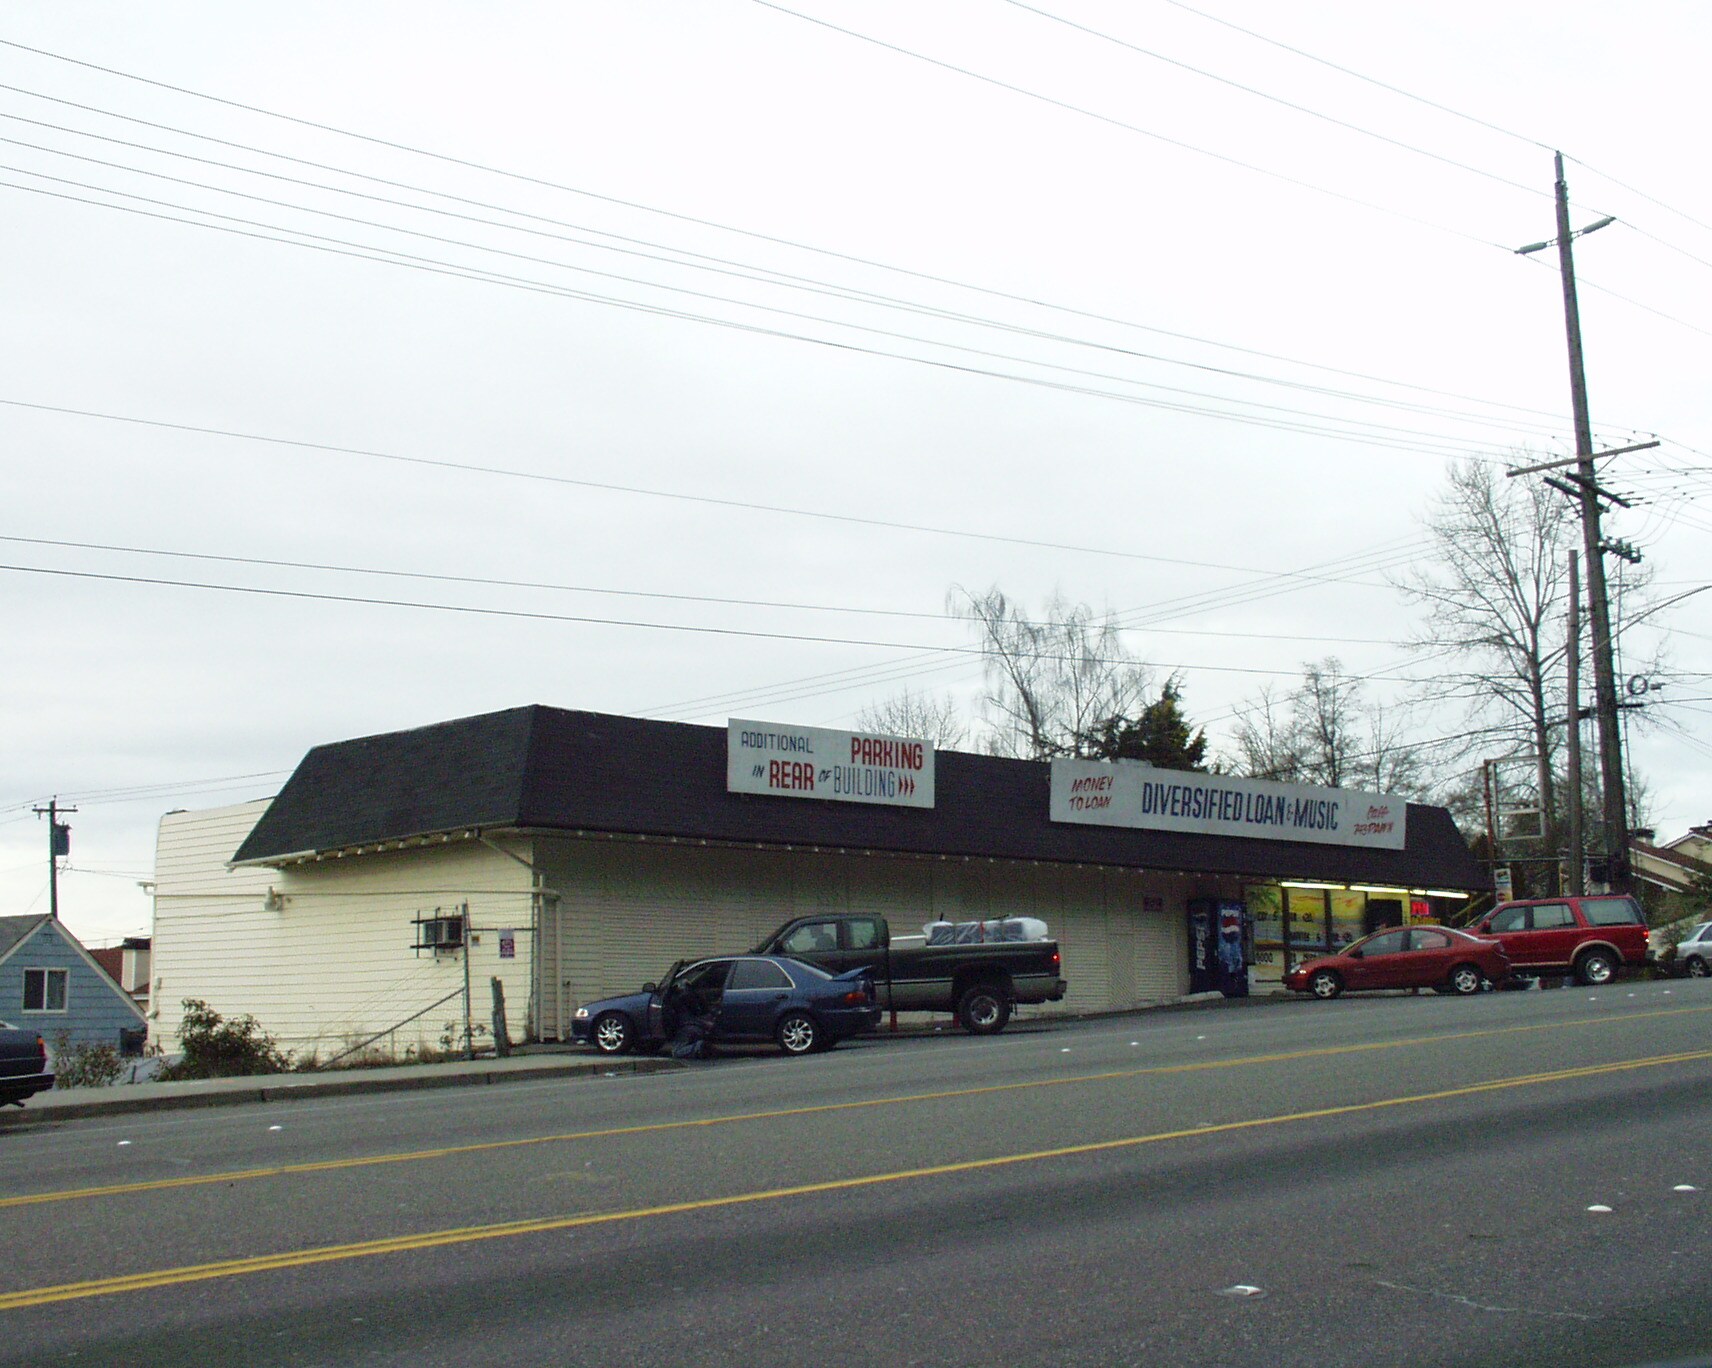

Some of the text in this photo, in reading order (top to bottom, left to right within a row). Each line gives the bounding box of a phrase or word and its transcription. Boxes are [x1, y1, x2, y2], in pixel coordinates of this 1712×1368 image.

[741, 731, 923, 771] ADDITIONAL PARKING
[752, 759, 895, 798] IN REAR OF BUILDING
[1071, 776, 1114, 792] MONEY
[1142, 782, 1242, 821] DIVERSIFIED
[1246, 793, 1285, 826] LOAN
[1293, 798, 1339, 831] MUSIC
